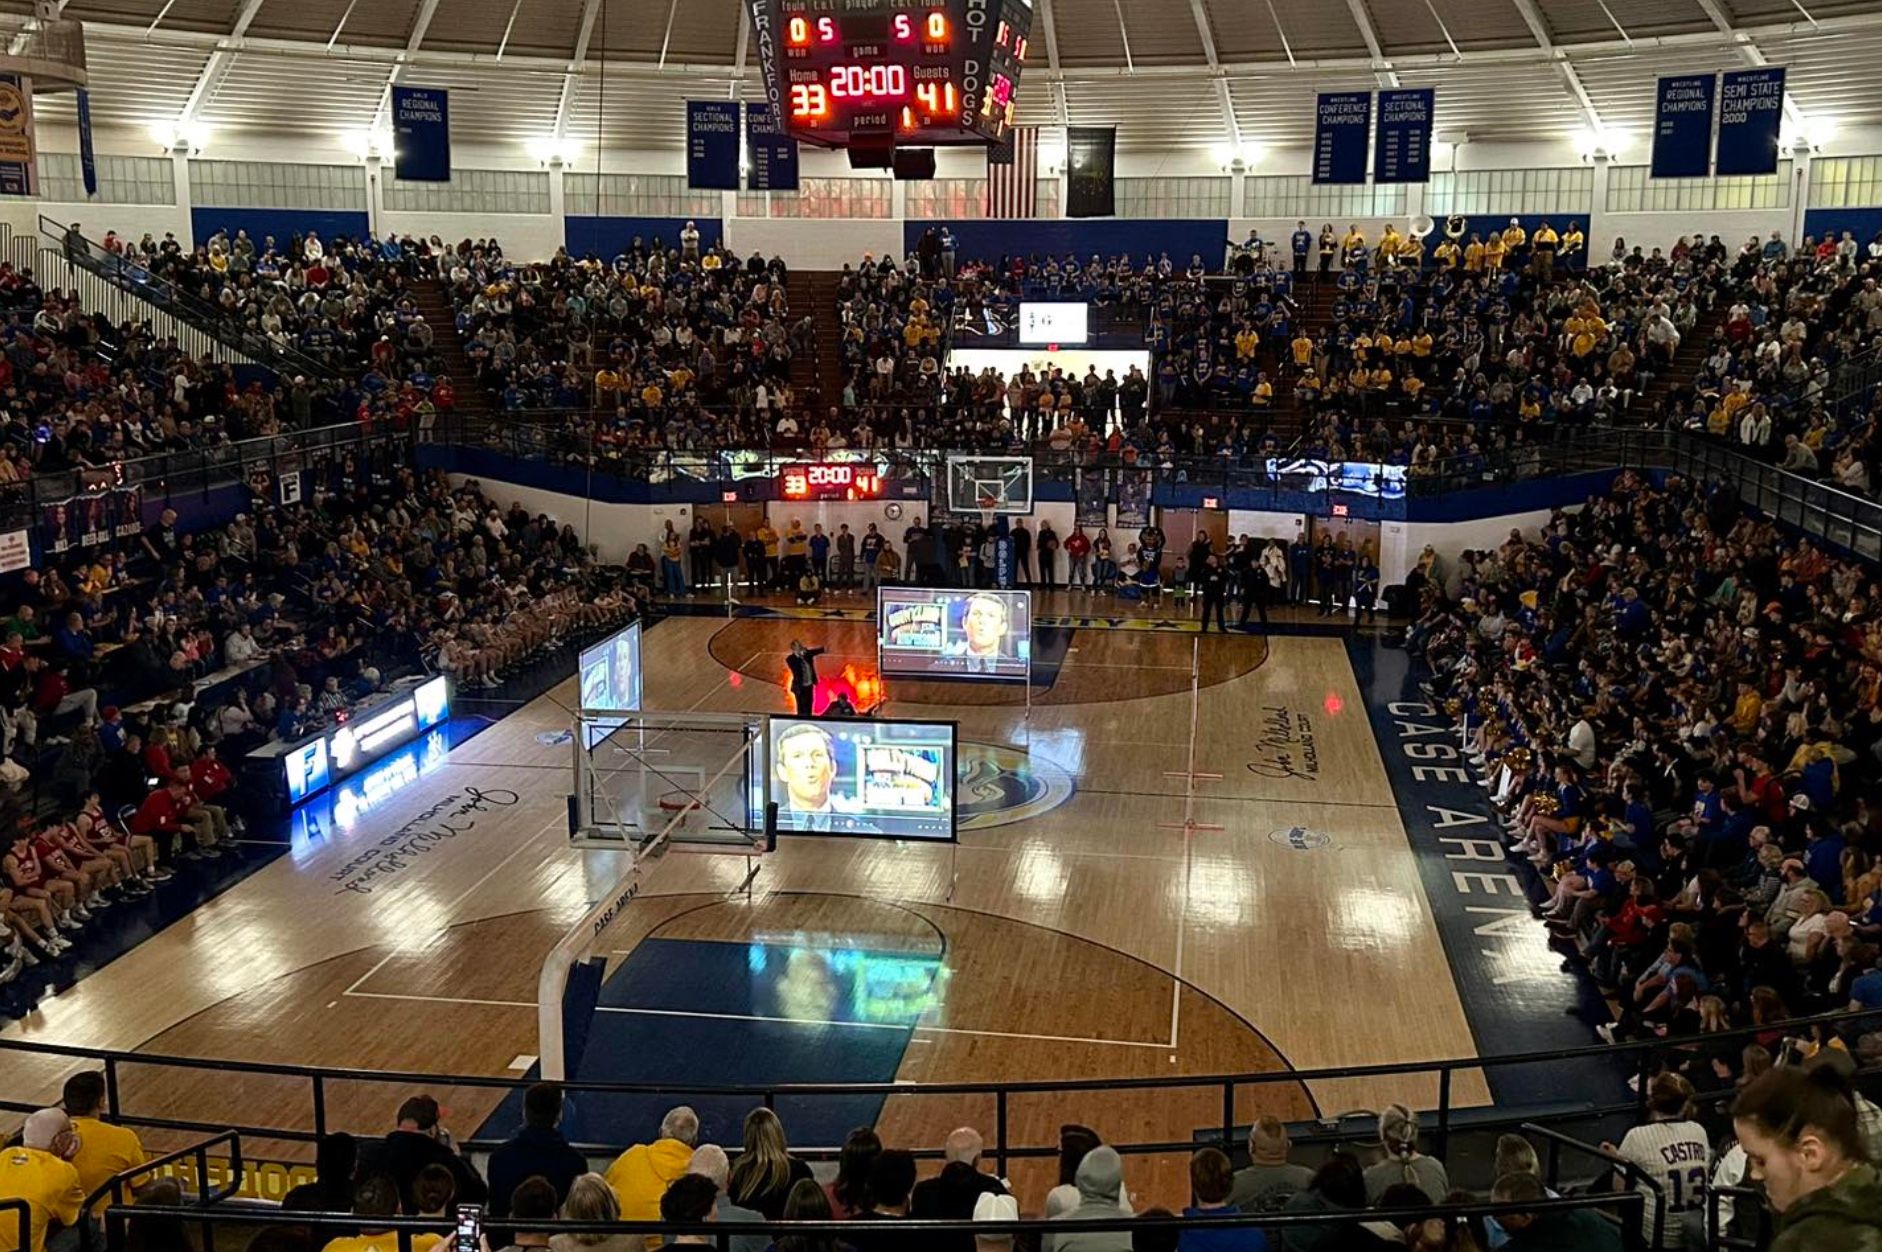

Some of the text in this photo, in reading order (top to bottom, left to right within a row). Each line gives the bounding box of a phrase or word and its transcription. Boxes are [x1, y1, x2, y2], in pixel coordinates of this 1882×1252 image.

[790, 17, 806, 42] 0
[818, 17, 833, 40] 5
[895, 14, 910, 38] 5
[928, 12, 944, 38] 0
[787, 48, 806, 57] won
[853, 46, 878, 58] game
[925, 44, 944, 53] won
[753, 1, 781, 130] FRANKFORT
[913, 66, 949, 79] Guests
[789, 69, 818, 82] Home
[830, 65, 904, 97] 20:00
[917, 81, 953, 112] 41
[962, 60, 979, 126] DOGS
[1666, 88, 1705, 100] REGIONAL
[1724, 81, 1780, 98] SEMI STATE
[402, 98, 439, 110] REGIONAL
[791, 84, 826, 115] 33
[1384, 100, 1427, 112] SECTIONAL
[1662, 100, 1707, 113] CHAMPIONS
[1723, 96, 1779, 112] CHAMPIONS
[399, 109, 442, 122] CHAMPIONS
[693, 112, 734, 122] SECTIONAL
[902, 105, 912, 127] 1
[1319, 103, 1368, 114] CONFERENCE
[1384, 112, 1426, 122] CHAMPIONS
[748, 113, 772, 123] CONFE
[854, 114, 886, 126] period
[1322, 114, 1364, 125] CHAMPIONS
[1722, 112, 1747, 124] 2000
[693, 123, 735, 133] CHAMPIONS
[808, 466, 851, 484] 20:00
[283, 481, 297, 501] F
[785, 475, 807, 494] 33
[856, 475, 878, 493] 41
[1387, 702, 1470, 783] CASE
[451, 787, 519, 818] John
[330, 795, 462, 881] MILHOLLAND COURT
[594, 882, 638, 937] CASE ARENA
[1667, 1166, 1706, 1213] 13
